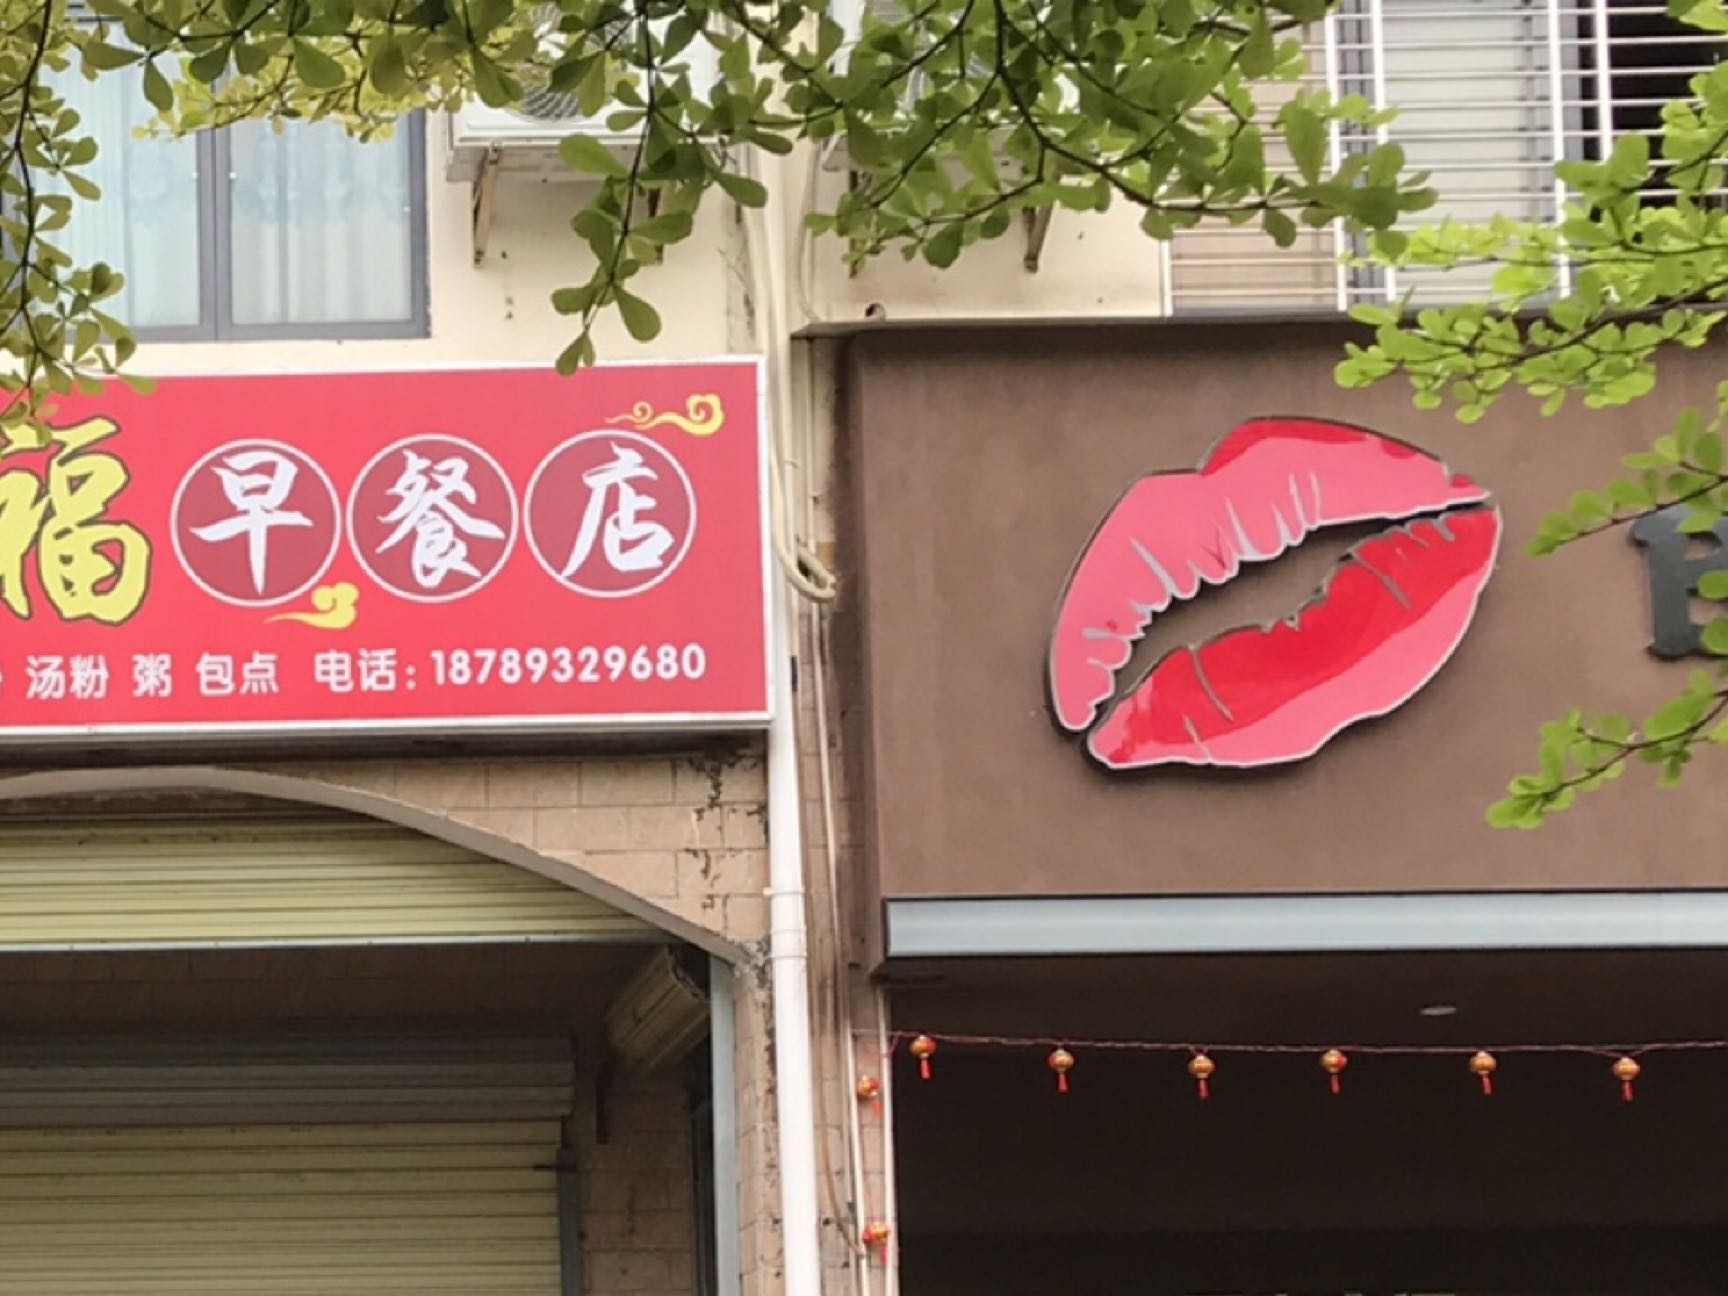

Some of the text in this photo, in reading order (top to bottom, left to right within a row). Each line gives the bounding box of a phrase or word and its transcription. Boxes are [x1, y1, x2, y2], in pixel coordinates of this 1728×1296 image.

[172, 430, 697, 606] 早餐店
[26, 654, 108, 700] 汤粉
[133, 653, 172, 697] 粥
[195, 652, 280, 696] 包点
